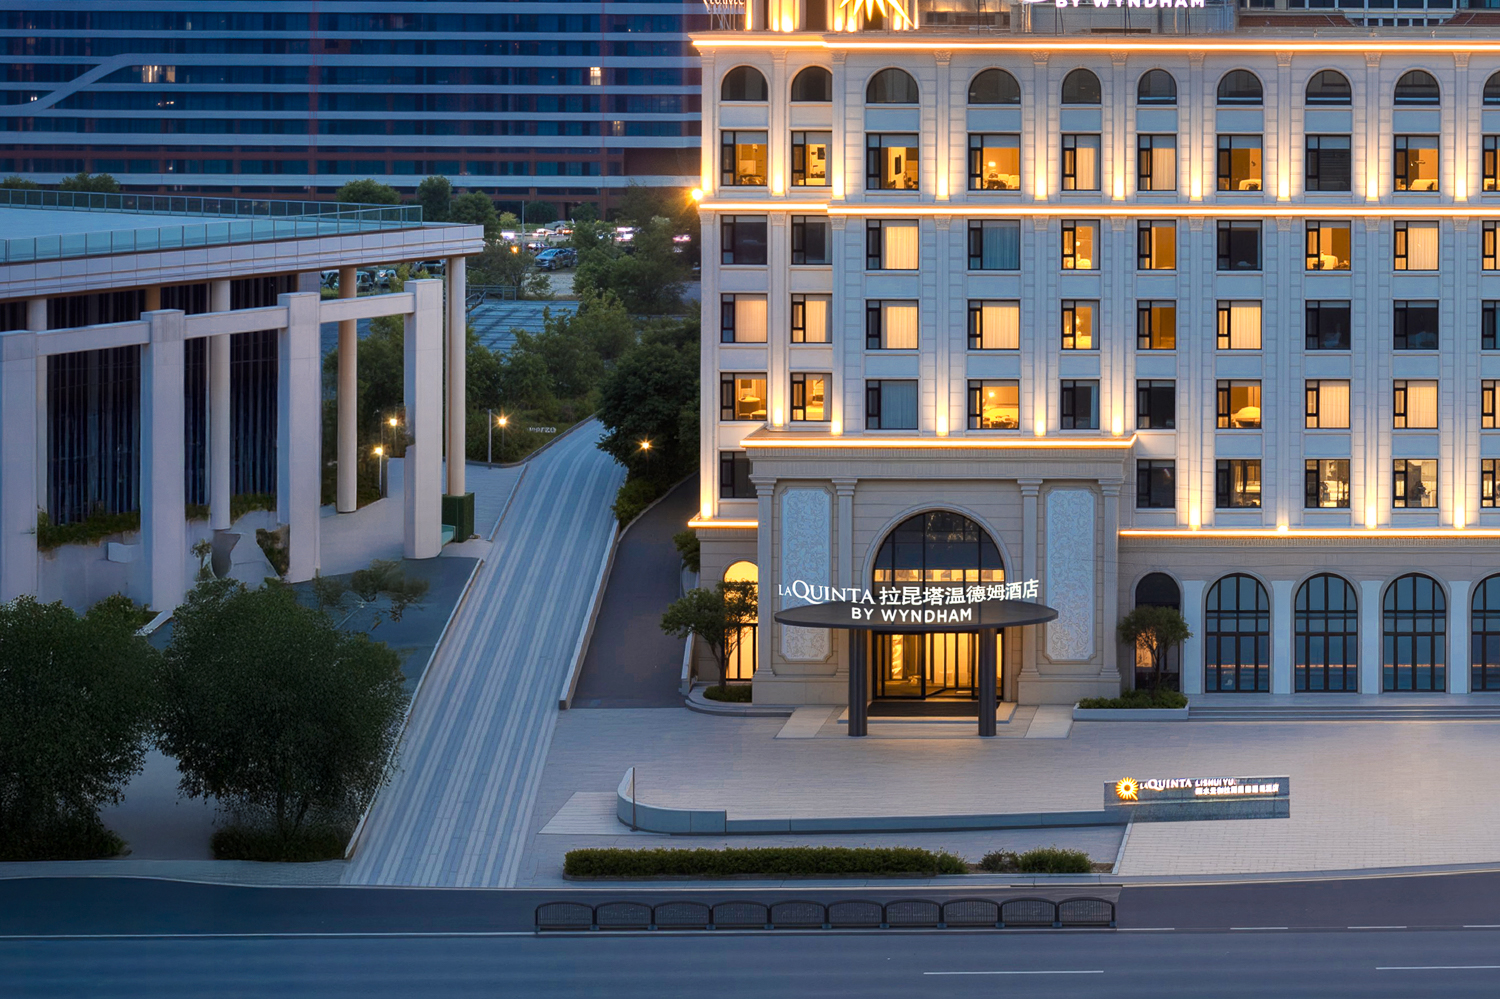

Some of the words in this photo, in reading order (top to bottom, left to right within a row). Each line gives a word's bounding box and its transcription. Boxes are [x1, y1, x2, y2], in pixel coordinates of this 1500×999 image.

[778, 584, 793, 597] LA
[792, 579, 877, 605] QUINTA
[879, 578, 1039, 607] 拉昆塔温德姆酒店
[851, 607, 874, 621] BY
[881, 607, 972, 623] WYNDHAM
[1147, 778, 1193, 792] QUINTA
